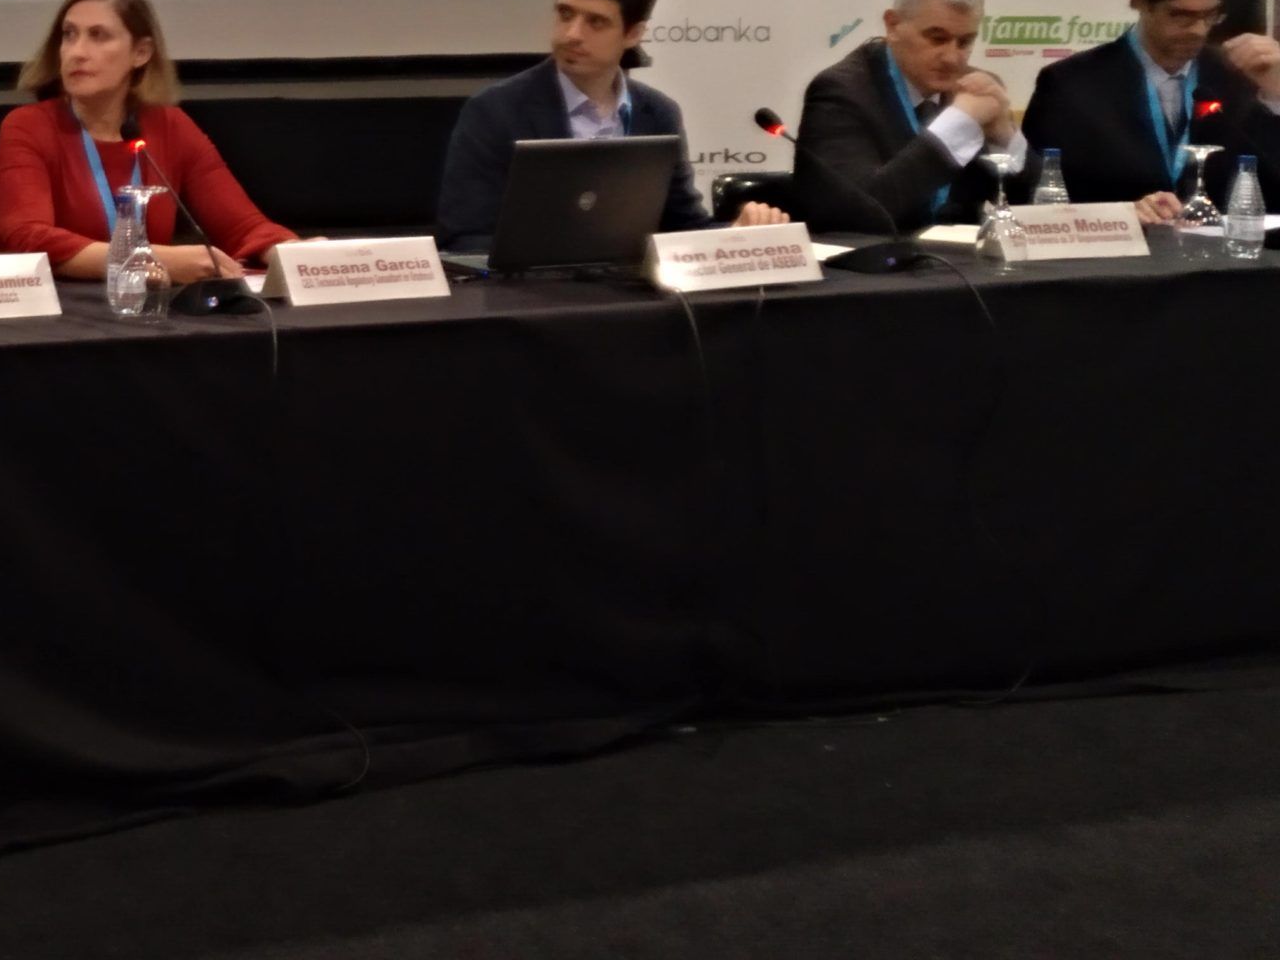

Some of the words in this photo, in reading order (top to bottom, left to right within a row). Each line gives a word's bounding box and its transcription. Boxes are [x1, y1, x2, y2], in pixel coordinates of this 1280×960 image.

[640, 17, 771, 43] cobanka
[1075, 218, 1128, 233] Molero
[715, 244, 802, 260] Arocena
[297, 263, 370, 277] Rossana
